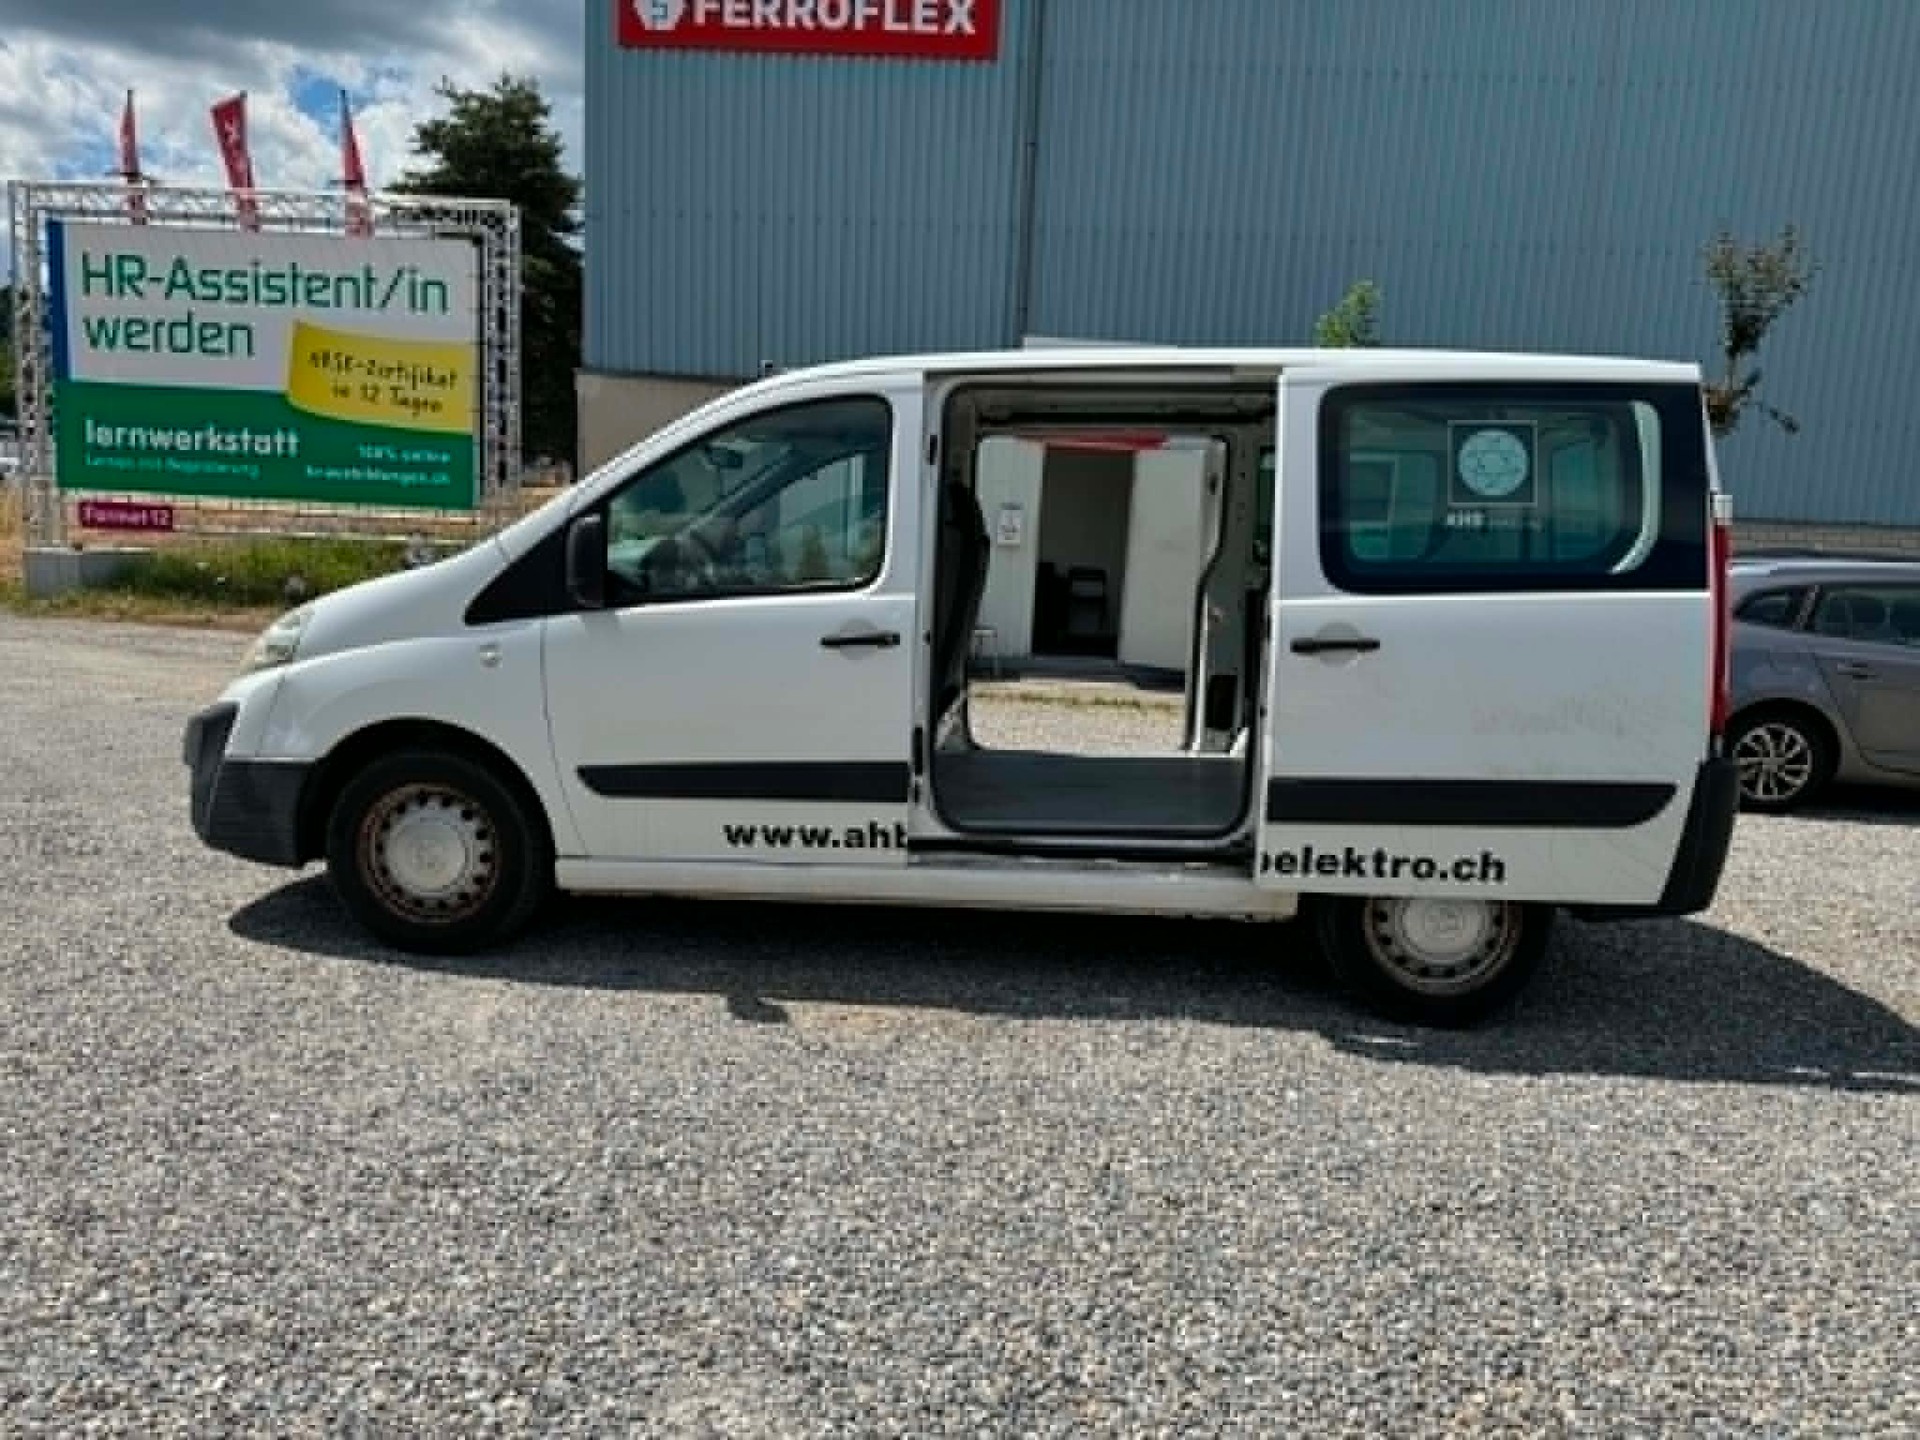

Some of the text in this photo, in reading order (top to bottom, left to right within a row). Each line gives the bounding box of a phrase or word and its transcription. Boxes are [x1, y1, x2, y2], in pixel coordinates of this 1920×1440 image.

[693, 0, 976, 35] FERROFLEX
[82, 252, 449, 313] HR-Assistent/in
[84, 309, 255, 357] werden
[360, 382, 381, 404] 12
[85, 418, 299, 457] lernwerkstatt
